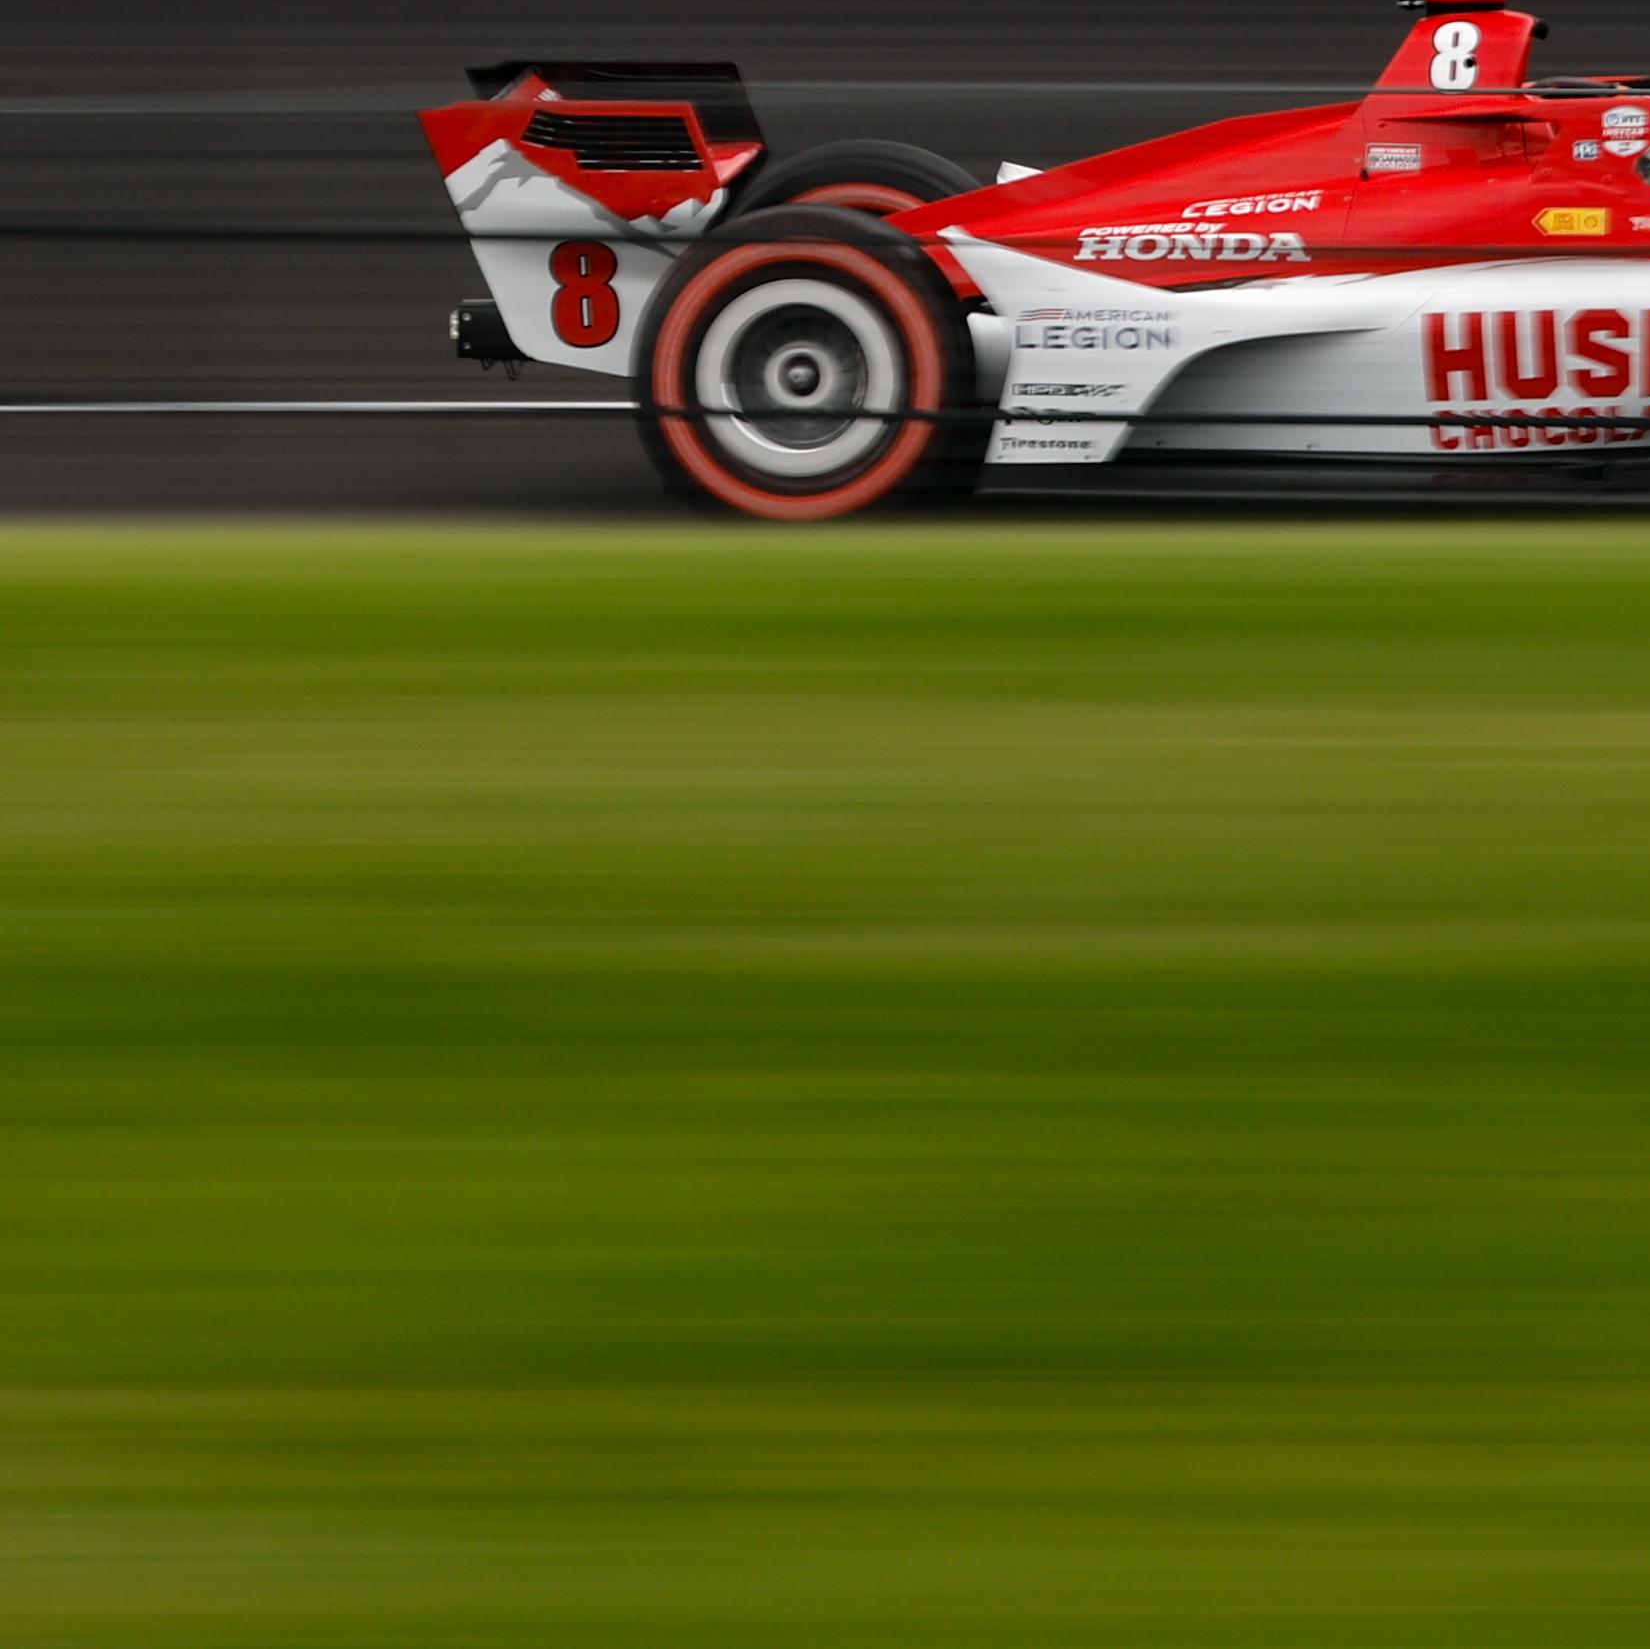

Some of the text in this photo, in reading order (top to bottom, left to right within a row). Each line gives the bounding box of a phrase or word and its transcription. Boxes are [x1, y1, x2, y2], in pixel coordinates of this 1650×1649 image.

[1428, 21, 1481, 92] 8
[1181, 195, 1321, 219] LEGION
[1080, 222, 1194, 237] POWERED
[1073, 233, 1312, 261] HONDA
[549, 241, 620, 347] 8
[1062, 309, 1170, 322] AMERICAN
[1015, 325, 1173, 350] LEGION
[1000, 437, 1092, 450] Firestone
